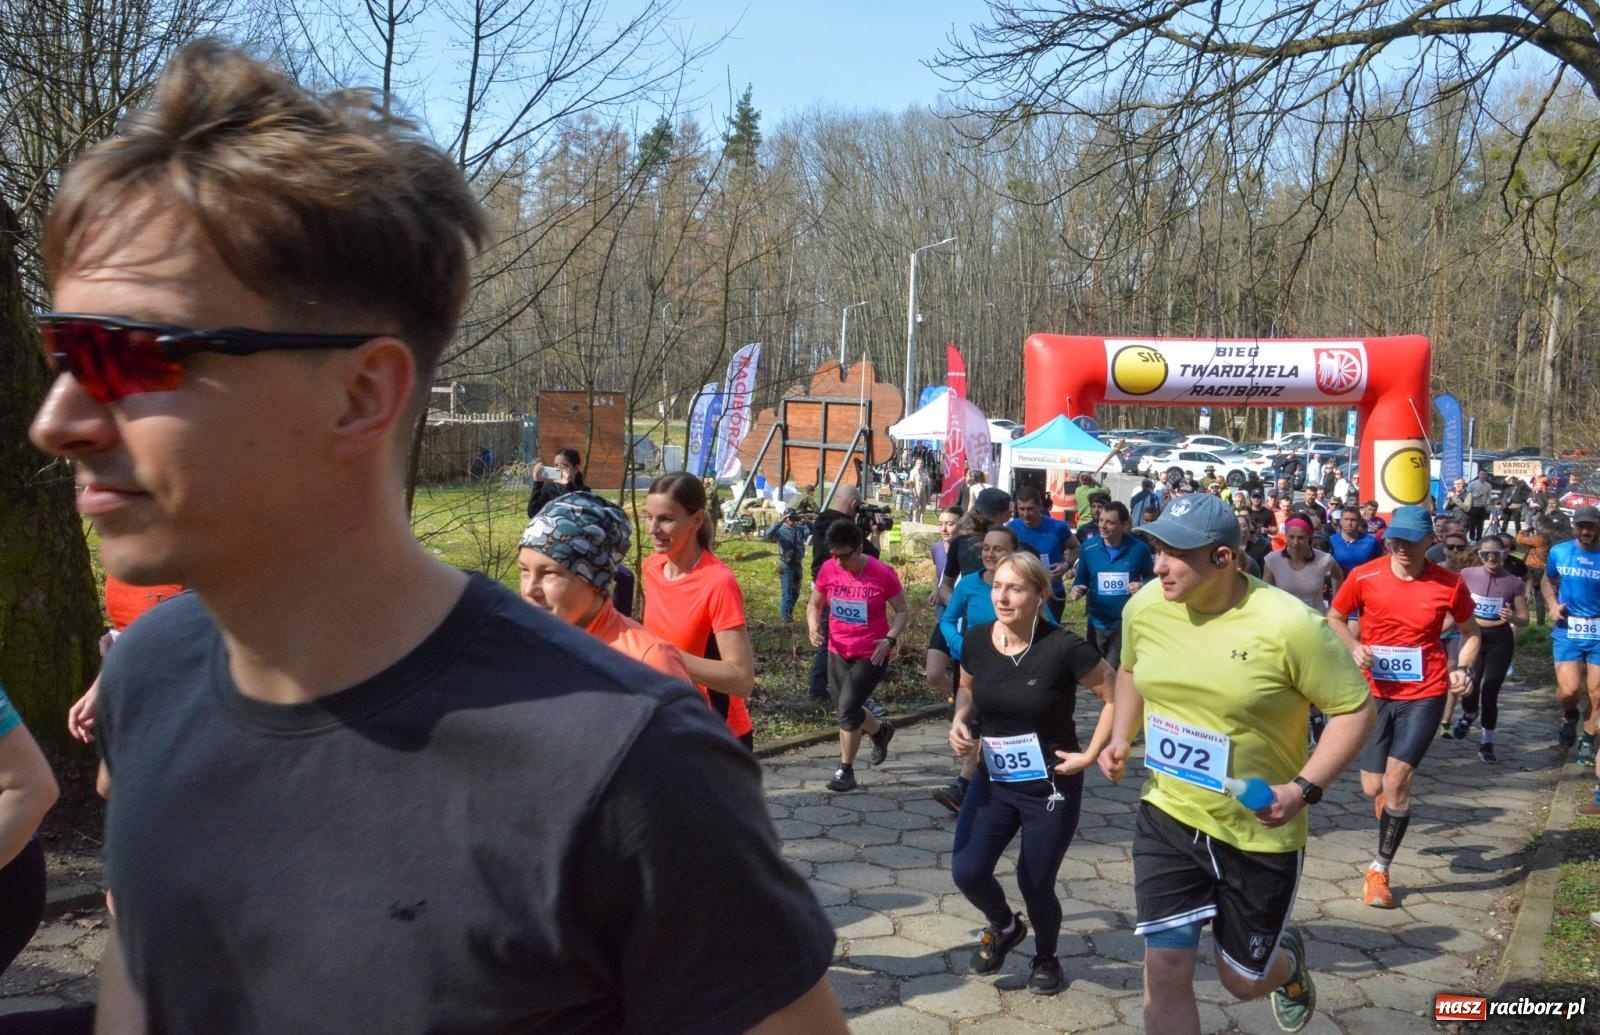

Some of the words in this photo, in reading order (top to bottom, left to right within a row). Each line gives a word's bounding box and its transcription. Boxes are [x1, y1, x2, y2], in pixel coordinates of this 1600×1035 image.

[1215, 347, 1259, 357] BIEG
[1180, 364, 1299, 378] TWARDZIELA
[1189, 382, 1286, 397] RACIBÓRZ
[1103, 580, 1124, 589] 089
[836, 606, 861, 618] 002
[1475, 602, 1496, 612] 027
[1574, 623, 1597, 633] 036
[1379, 657, 1412, 671] 086
[1164, 721, 1180, 732] BIEG
[1182, 727, 1223, 743] TWARDZIELA
[993, 751, 1031, 770] 035
[1159, 737, 1210, 772] 072
